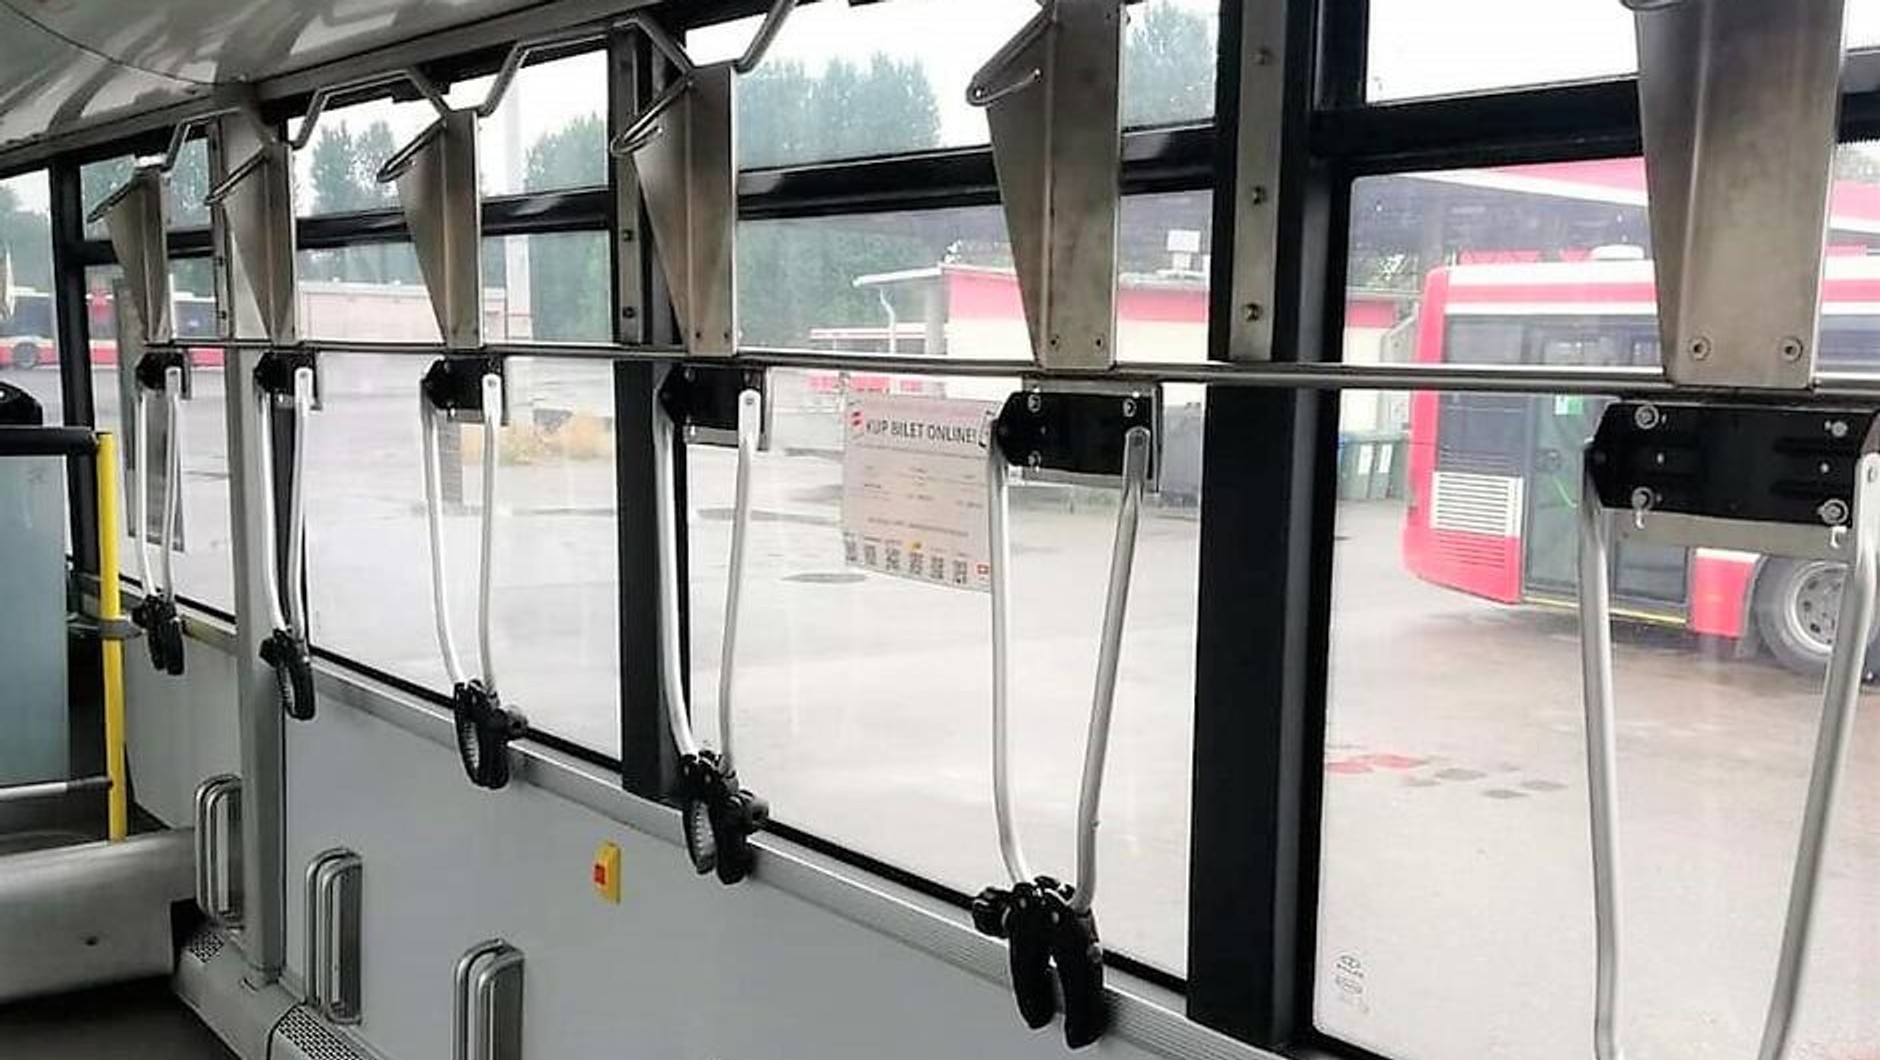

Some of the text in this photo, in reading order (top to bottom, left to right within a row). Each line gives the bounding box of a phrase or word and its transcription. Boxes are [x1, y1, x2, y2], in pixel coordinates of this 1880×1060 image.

[866, 419, 977, 444] KUP BILET ONLINE!
